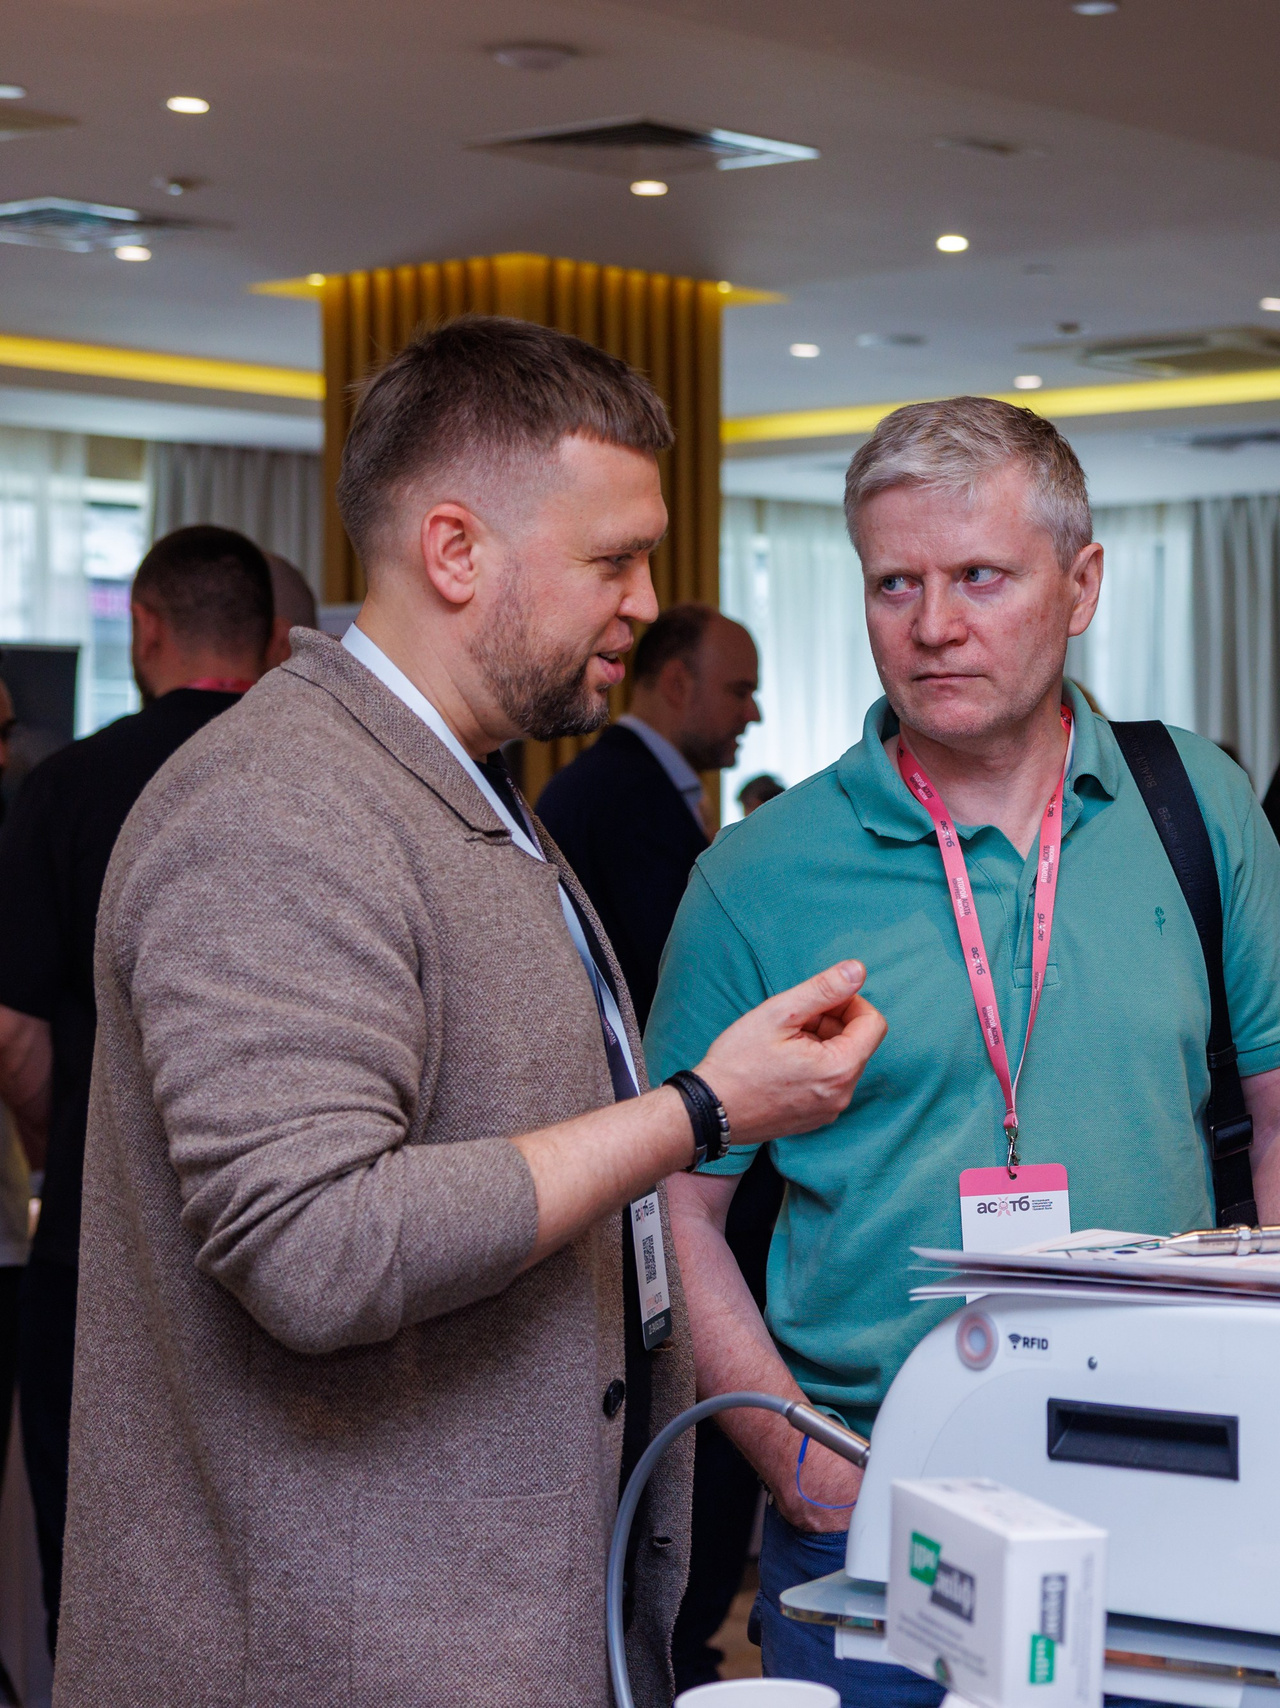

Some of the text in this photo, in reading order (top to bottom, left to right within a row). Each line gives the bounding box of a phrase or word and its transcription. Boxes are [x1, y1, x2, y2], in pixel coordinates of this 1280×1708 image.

[1040, 860, 1049, 883] ВТОРОЙ
[956, 877, 971, 916] ВТОРОЙ АСХТБ
[986, 1005, 997, 1027] ВТОРОЙ
[1022, 1336, 1049, 1350] RFID
